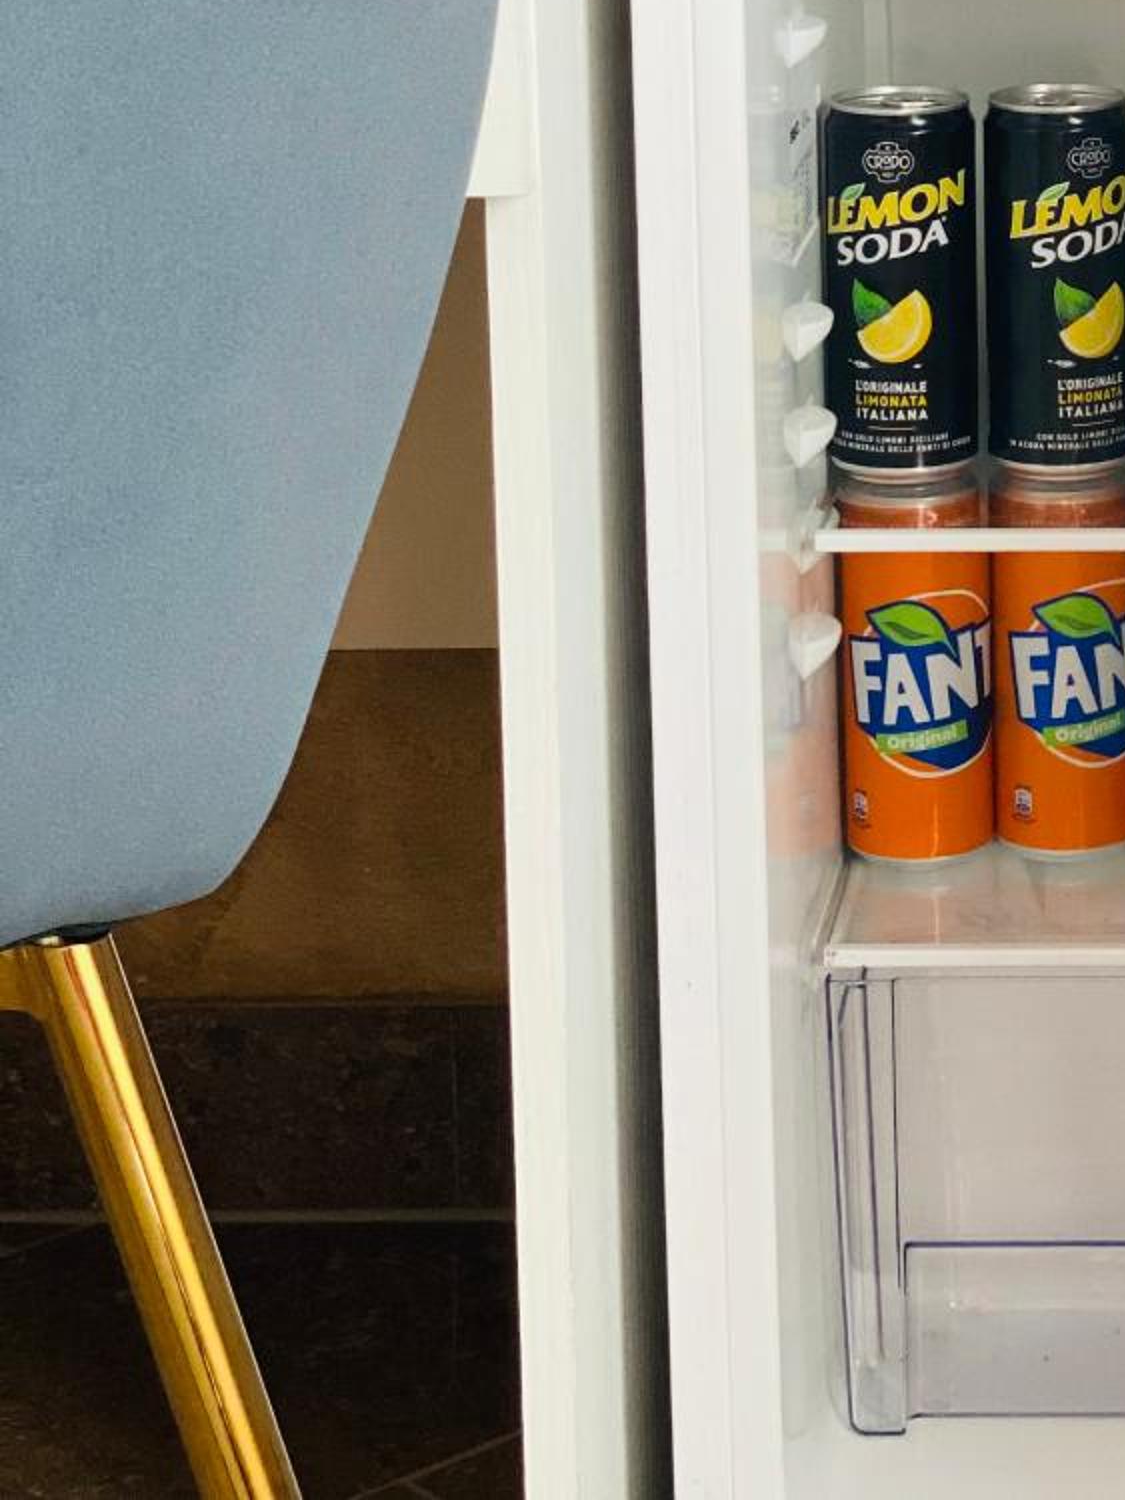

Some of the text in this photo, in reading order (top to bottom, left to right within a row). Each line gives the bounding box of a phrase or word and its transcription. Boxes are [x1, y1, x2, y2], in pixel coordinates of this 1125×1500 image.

[828, 168, 965, 234] LEMON
[838, 218, 949, 266] SODA
[855, 380, 927, 393] L'ORIGINALE
[1057, 371, 1123, 391] L'ORIGINALE
[855, 393, 928, 407] LIMONATA
[1057, 385, 1123, 405] LIMONATA
[856, 408, 929, 420] ITALIANA
[1058, 399, 1123, 418] ITALIANA
[850, 618, 991, 726] FANT
